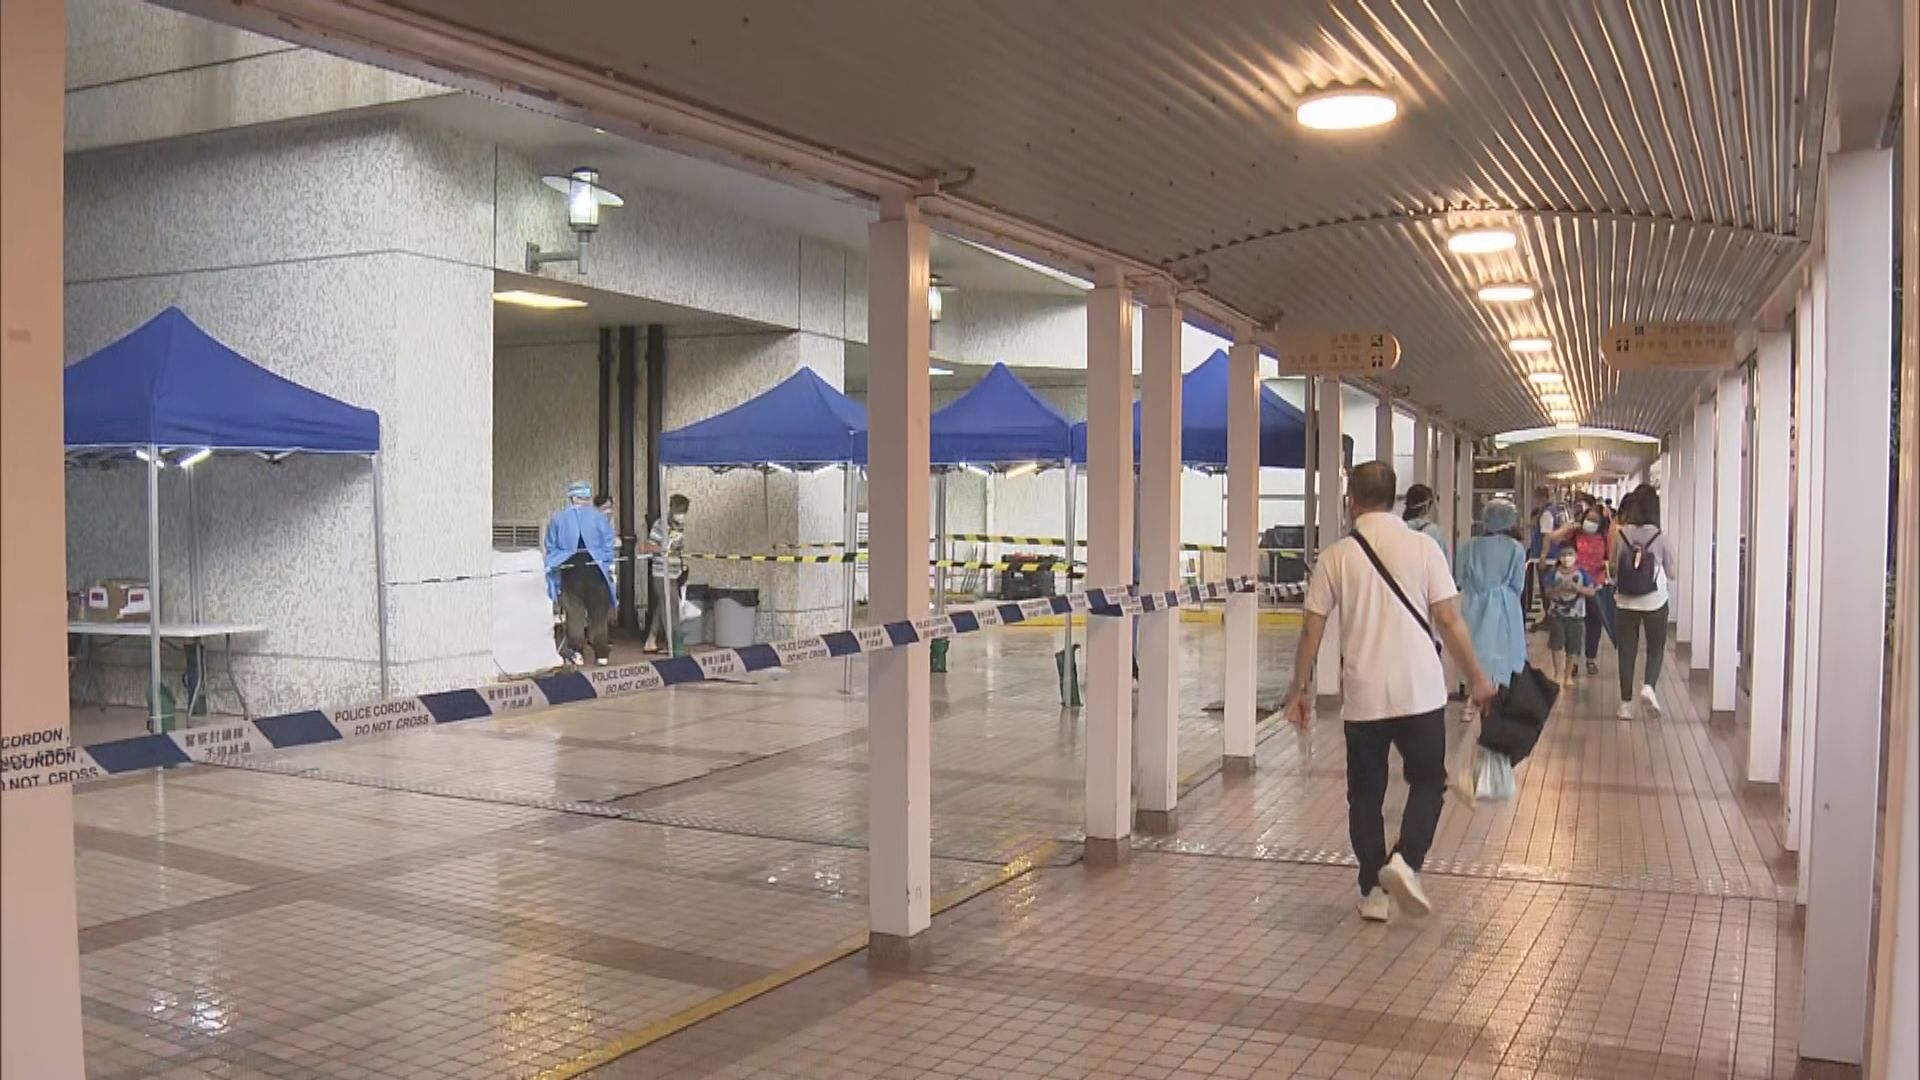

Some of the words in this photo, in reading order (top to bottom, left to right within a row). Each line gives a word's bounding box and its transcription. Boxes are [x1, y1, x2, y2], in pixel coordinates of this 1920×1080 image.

[335, 706, 371, 723] POLICE
[355, 724, 370, 736] DO
[371, 720, 392, 734] NOT
[396, 714, 429, 729] CROSS
[9, 776, 41, 790] NOT
[48, 766, 99, 785] CROSS
